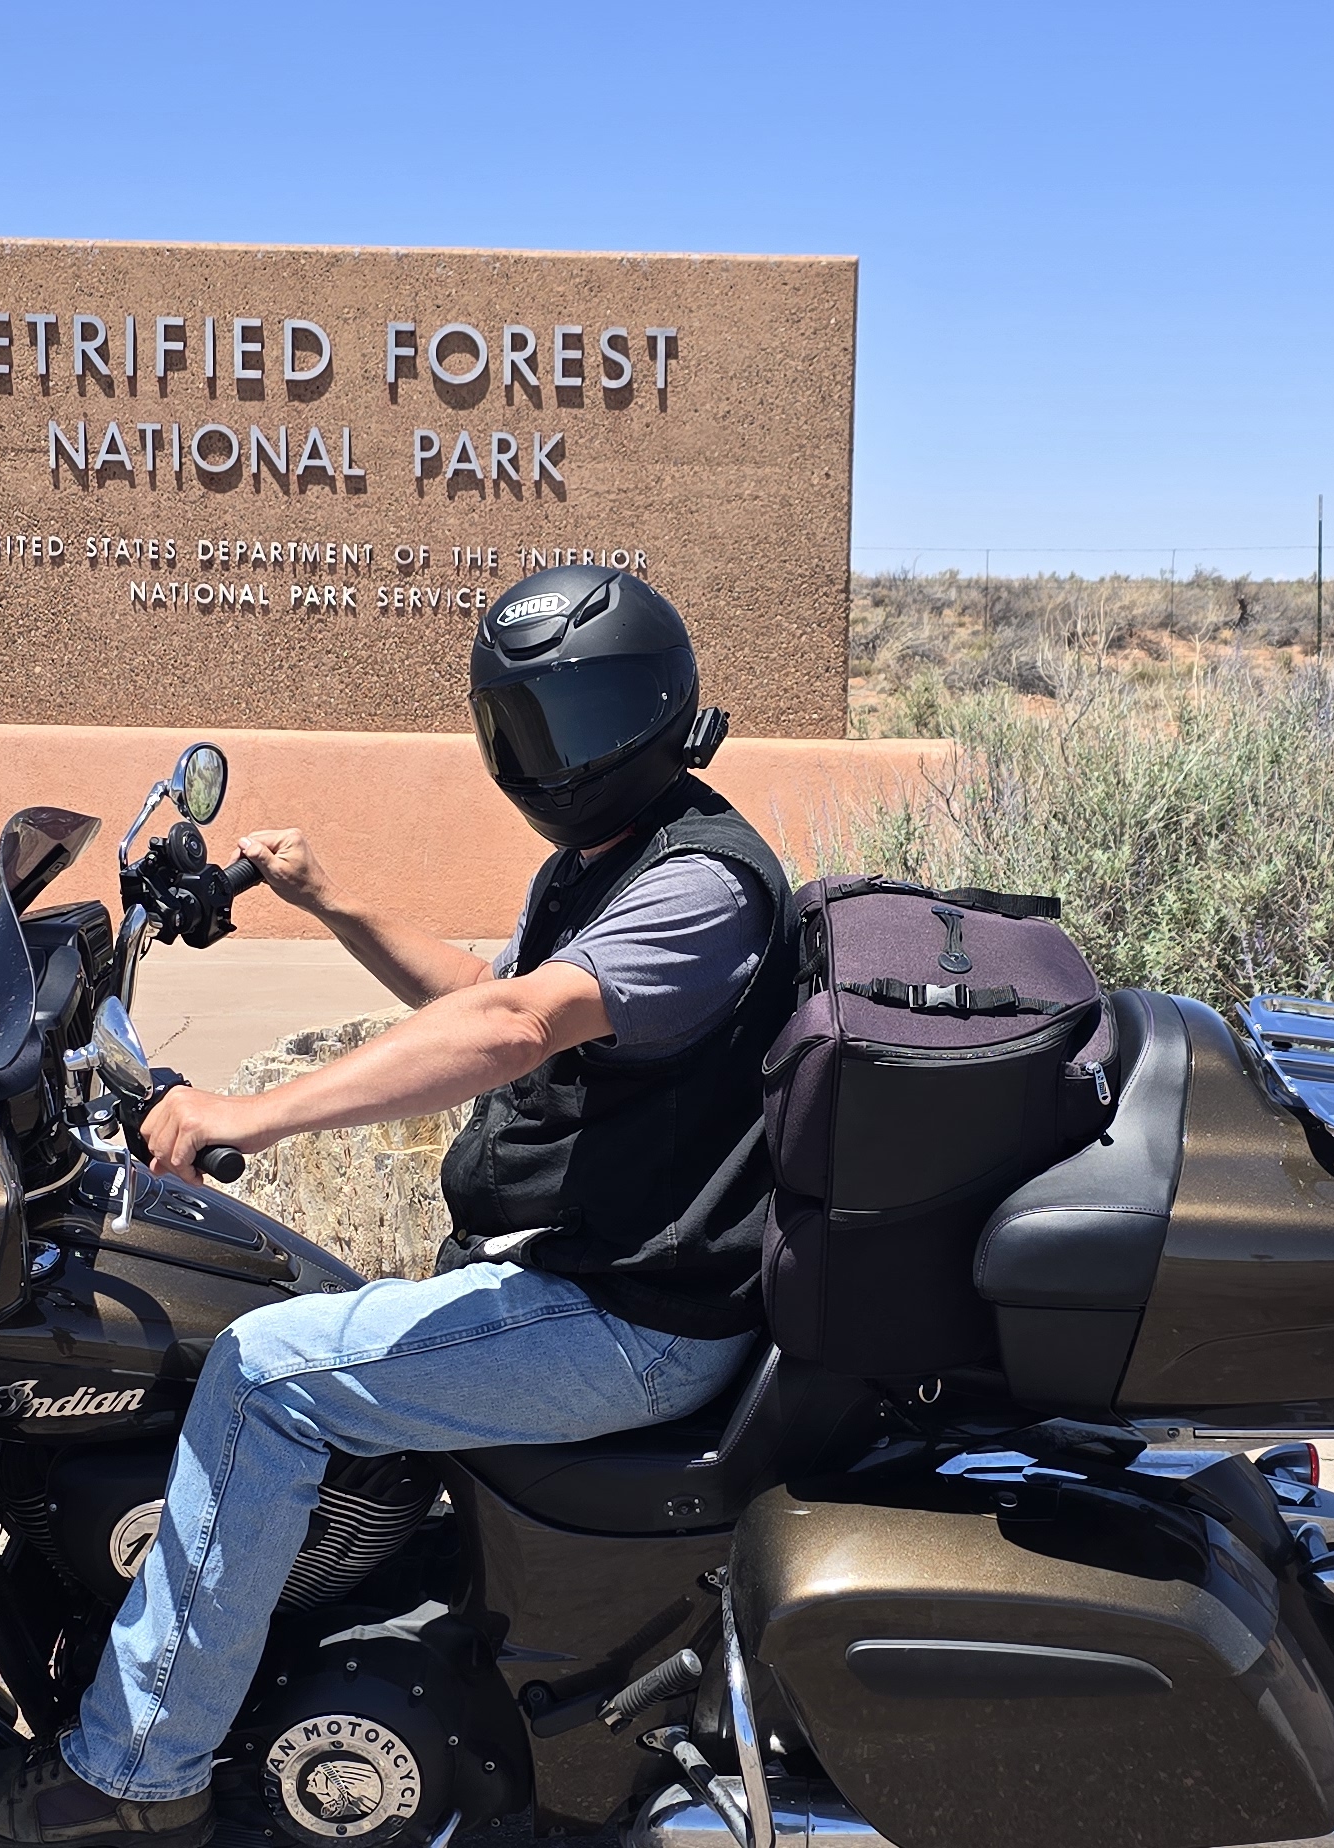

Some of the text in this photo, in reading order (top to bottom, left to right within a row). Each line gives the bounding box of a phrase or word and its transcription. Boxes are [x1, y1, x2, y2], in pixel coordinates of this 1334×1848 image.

[387, 323, 677, 389] FOREST
[49, 421, 565, 482] NATIONAL PARK
[86, 537, 177, 560] STATES
[198, 540, 373, 564] DEPARTMENT
[395, 544, 430, 566] OF
[452, 546, 499, 567] THE
[520, 547, 648, 569] INTERIOR
[130, 581, 488, 609] NATIONAL PARK SERVICE
[504, 595, 559, 623] SHOEI
[263, 1720, 416, 1828] NDIAN MOTORCYCLE
